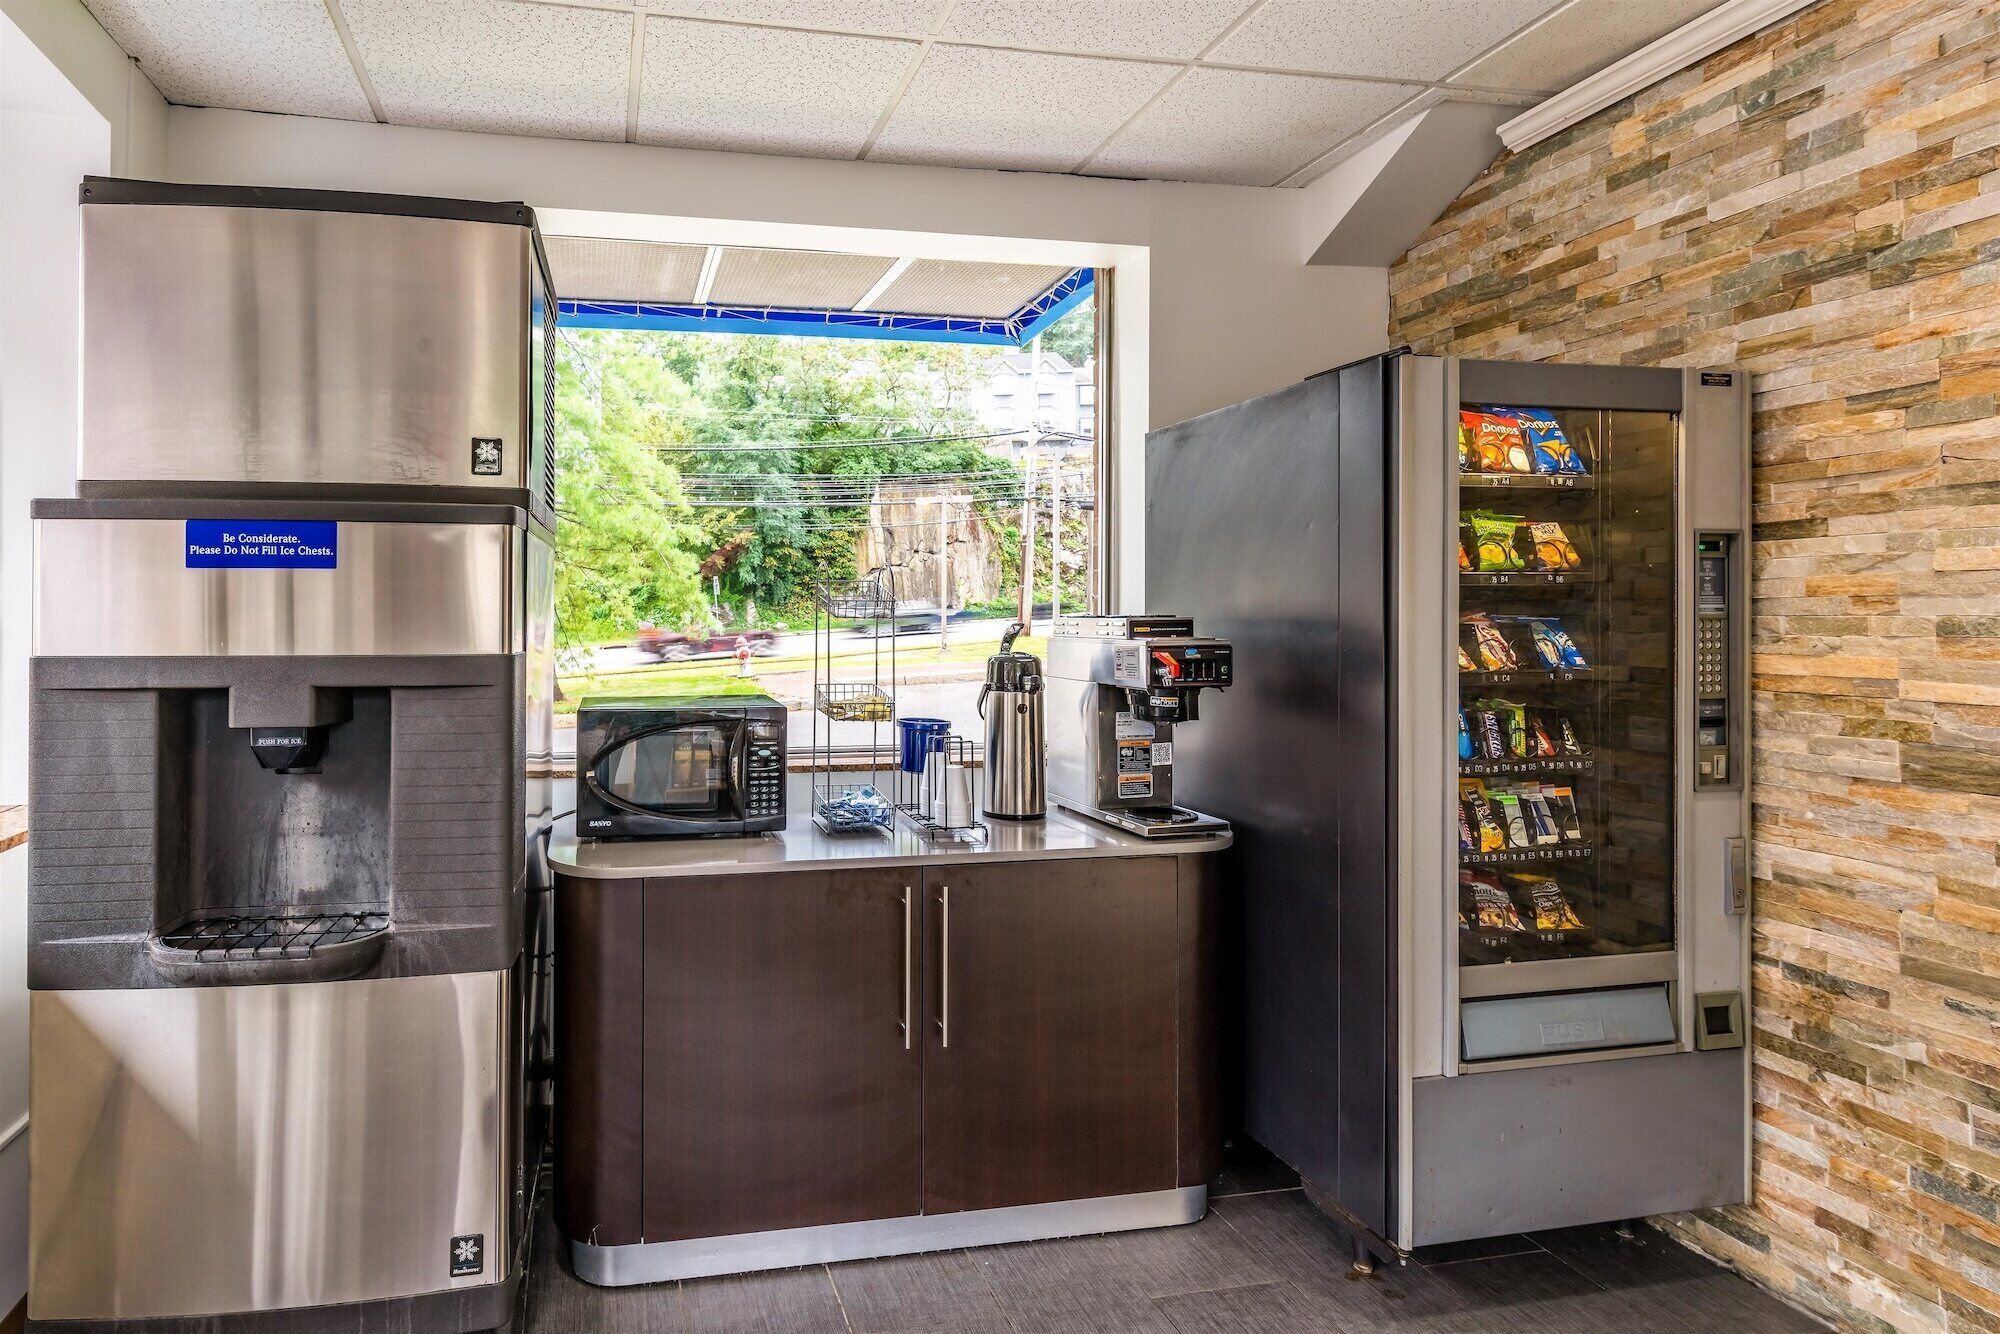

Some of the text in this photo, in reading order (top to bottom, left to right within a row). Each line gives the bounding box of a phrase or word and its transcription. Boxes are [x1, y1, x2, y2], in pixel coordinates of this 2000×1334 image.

[1481, 423, 1519, 435] Doritos
[1517, 419, 1560, 430] Doritos
[1501, 477, 1510, 485] A4
[1532, 523, 1557, 532] PARTY
[222, 533, 301, 544] Be Considerate.
[189, 545, 334, 556] Please Do Not Fill Ice Chests.
[1486, 714, 1504, 758] SNICKERS
[589, 819, 612, 827] SANYO
[1583, 849, 1592, 857] E7
